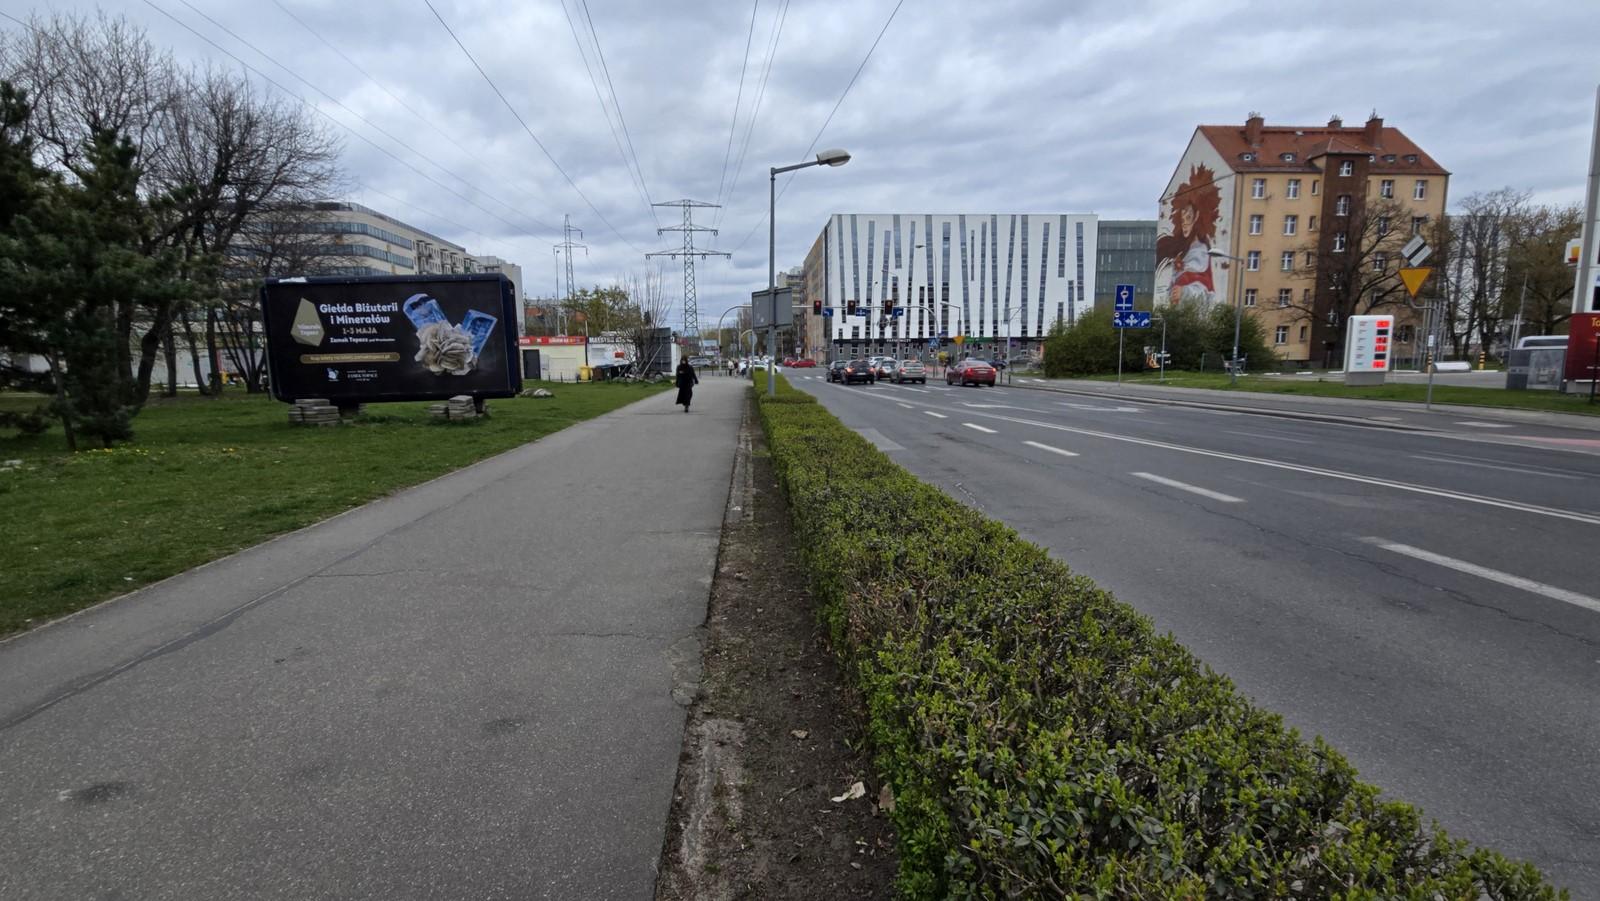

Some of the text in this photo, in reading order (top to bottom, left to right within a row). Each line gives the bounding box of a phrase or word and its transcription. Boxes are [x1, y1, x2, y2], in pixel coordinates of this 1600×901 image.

[320, 302, 398, 313] Giełda Biżuterii
[330, 314, 390, 325] i Minerałów
[355, 327, 378, 335] MAJA
